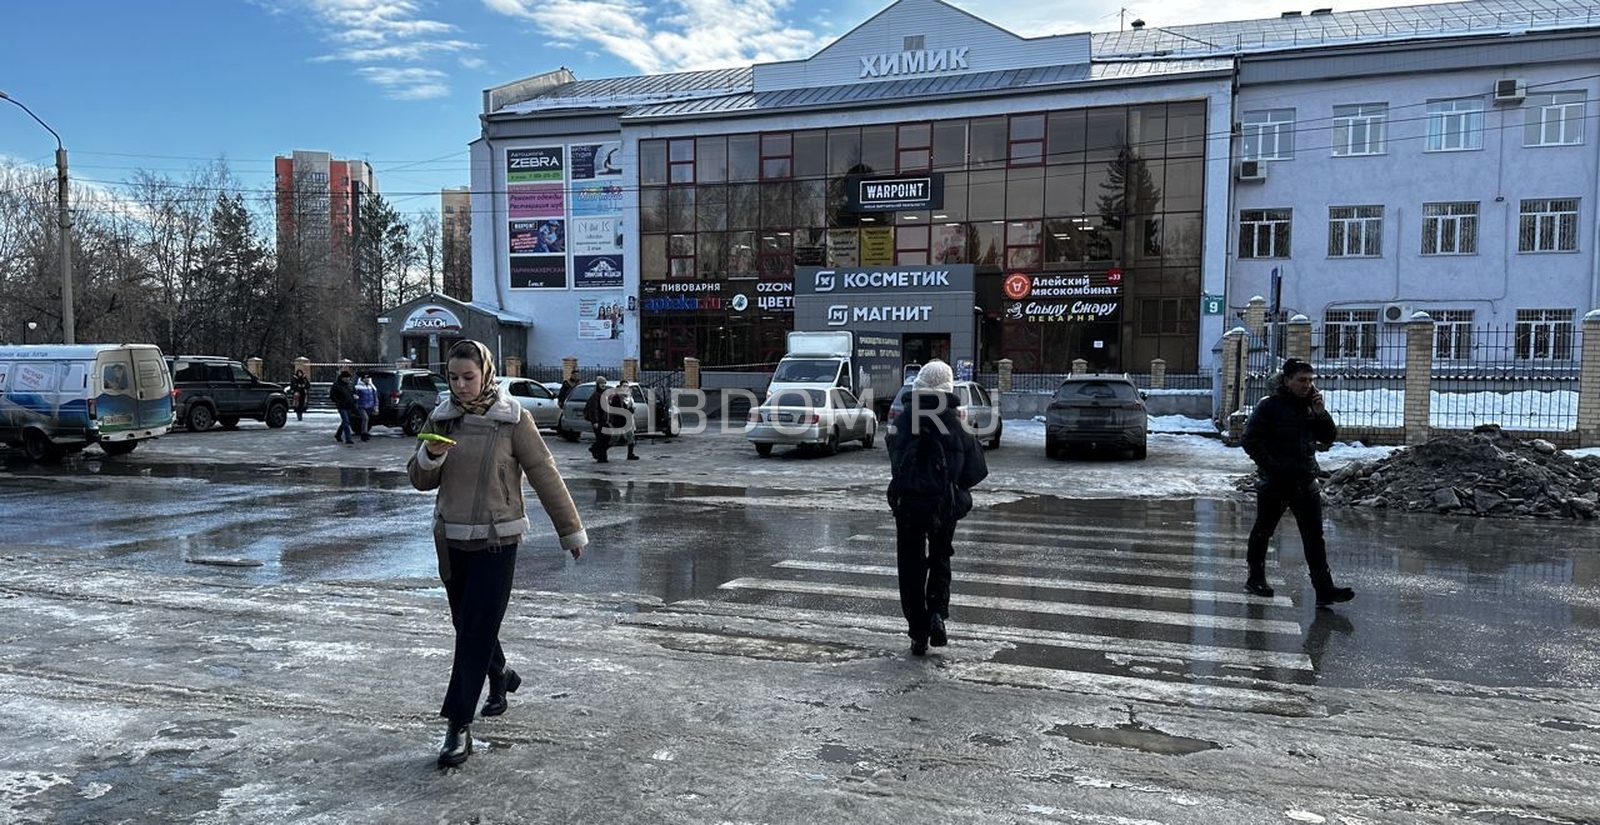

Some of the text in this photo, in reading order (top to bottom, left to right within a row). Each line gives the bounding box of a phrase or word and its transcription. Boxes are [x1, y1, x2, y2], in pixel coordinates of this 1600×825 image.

[860, 46, 969, 79] ХИМИК
[510, 156, 560, 169] ZEBRA
[866, 183, 924, 199] WARPOINT
[844, 271, 949, 287] КОСМЕТИК
[1032, 275, 1090, 287] Алейский
[661, 283, 721, 292] ПИВОВАРНЯ
[756, 282, 793, 292] OZON
[1031, 285, 1119, 296] мясокомбинат
[645, 293, 721, 314] apteka.ru
[758, 296, 795, 310] ЦВЕТ
[1025, 301, 1117, 317] Спылу Сжару
[1210, 302, 1218, 313] 9
[853, 306, 932, 321] МАГНИТ
[1028, 314, 1095, 322] ПЕКАРНЯ
